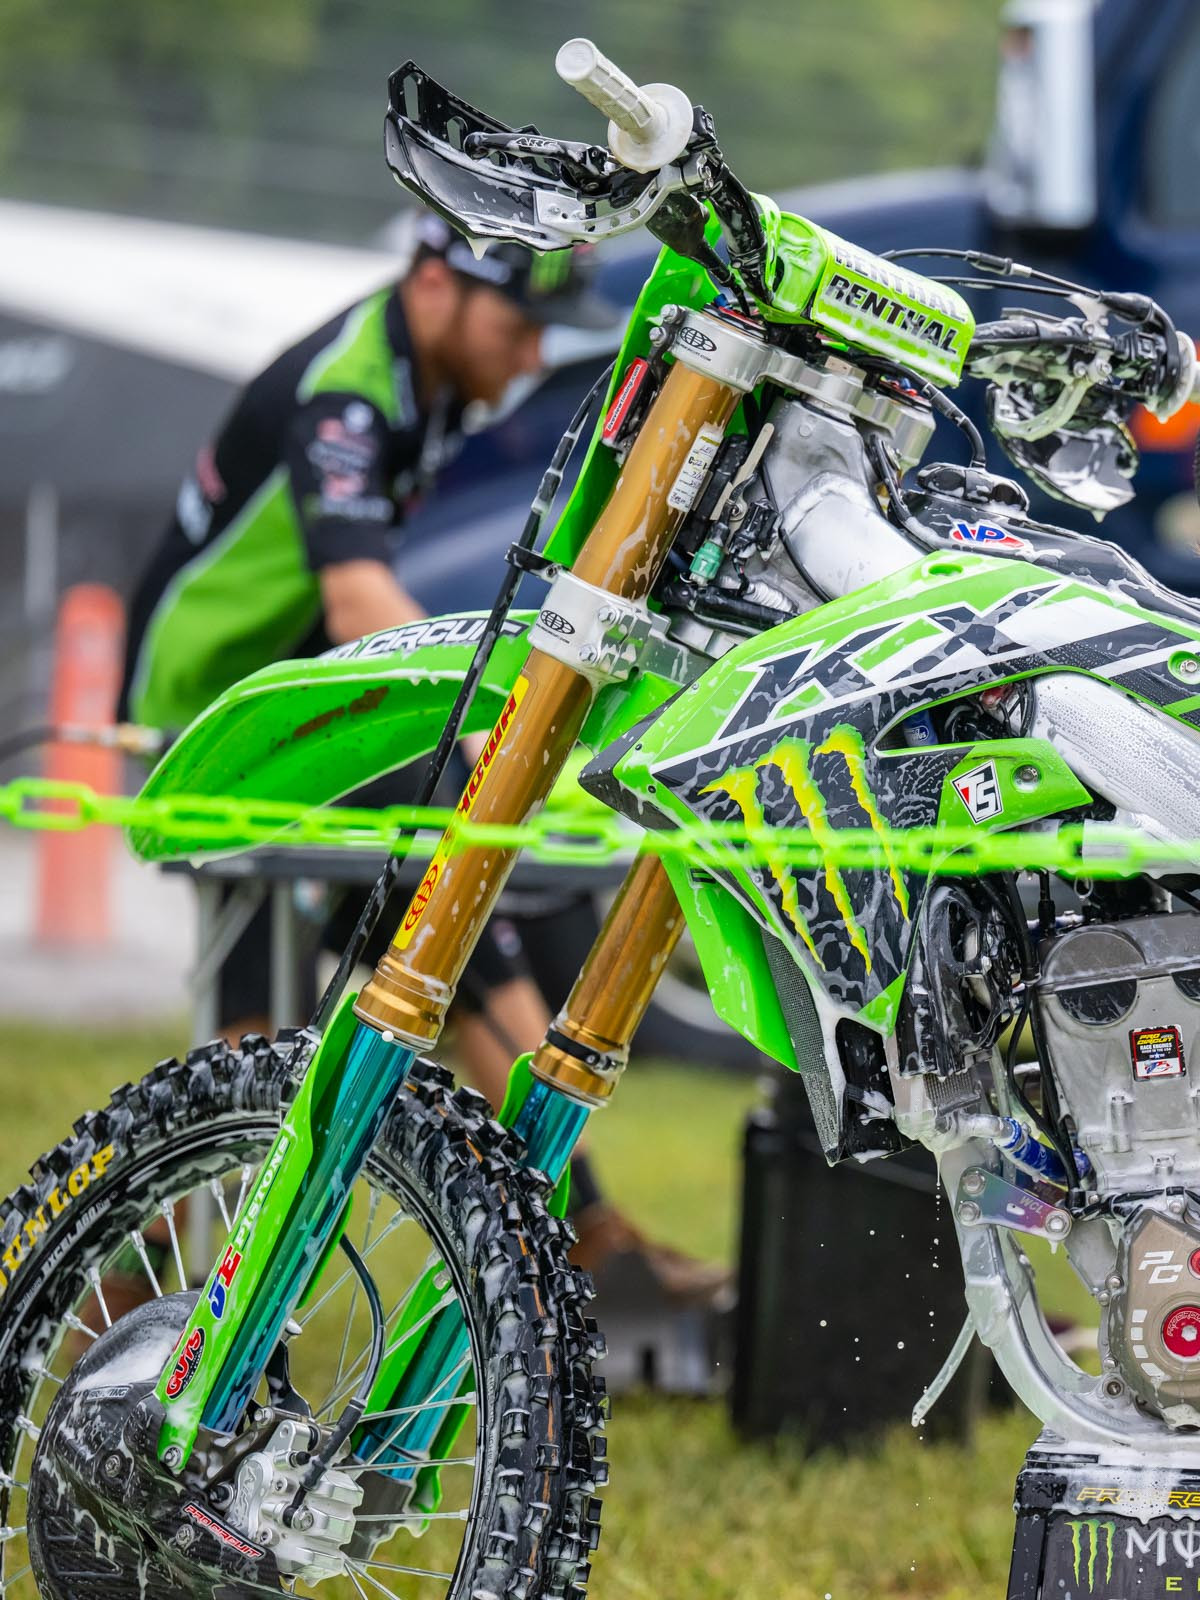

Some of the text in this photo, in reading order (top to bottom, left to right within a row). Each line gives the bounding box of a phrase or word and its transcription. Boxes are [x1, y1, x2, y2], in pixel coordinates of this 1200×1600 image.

[826, 275, 960, 354] RENTHAL
[956, 523, 1006, 542] VP
[443, 692, 517, 850] HOWA
[233, 1135, 290, 1248] PISTONS
[1019, 1195, 1044, 1214] WCL
[208, 1244, 242, 1320] JE
[1138, 1250, 1184, 1284] PC
[165, 1327, 201, 1397] GUTS
[184, 1503, 263, 1558] PRO CIRCUIT
